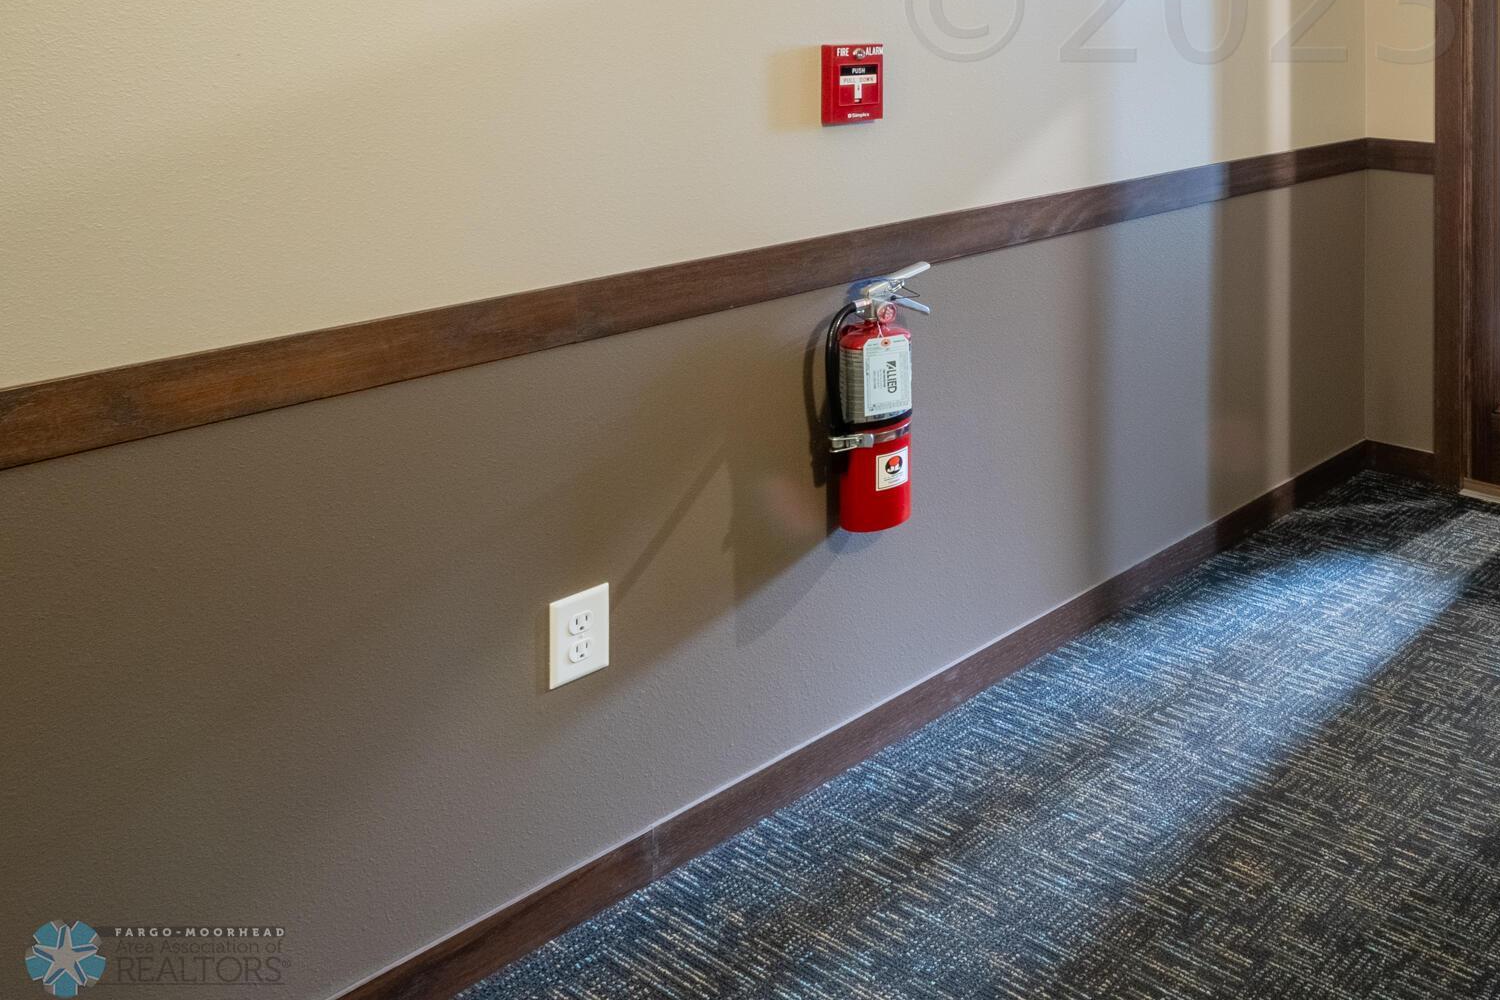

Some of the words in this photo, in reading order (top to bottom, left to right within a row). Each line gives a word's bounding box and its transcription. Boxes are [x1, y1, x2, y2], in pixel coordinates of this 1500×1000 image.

[837, 47, 849, 56] FIRE
[866, 46, 884, 55] ALARM
[887, 360, 897, 393] ALLIED
